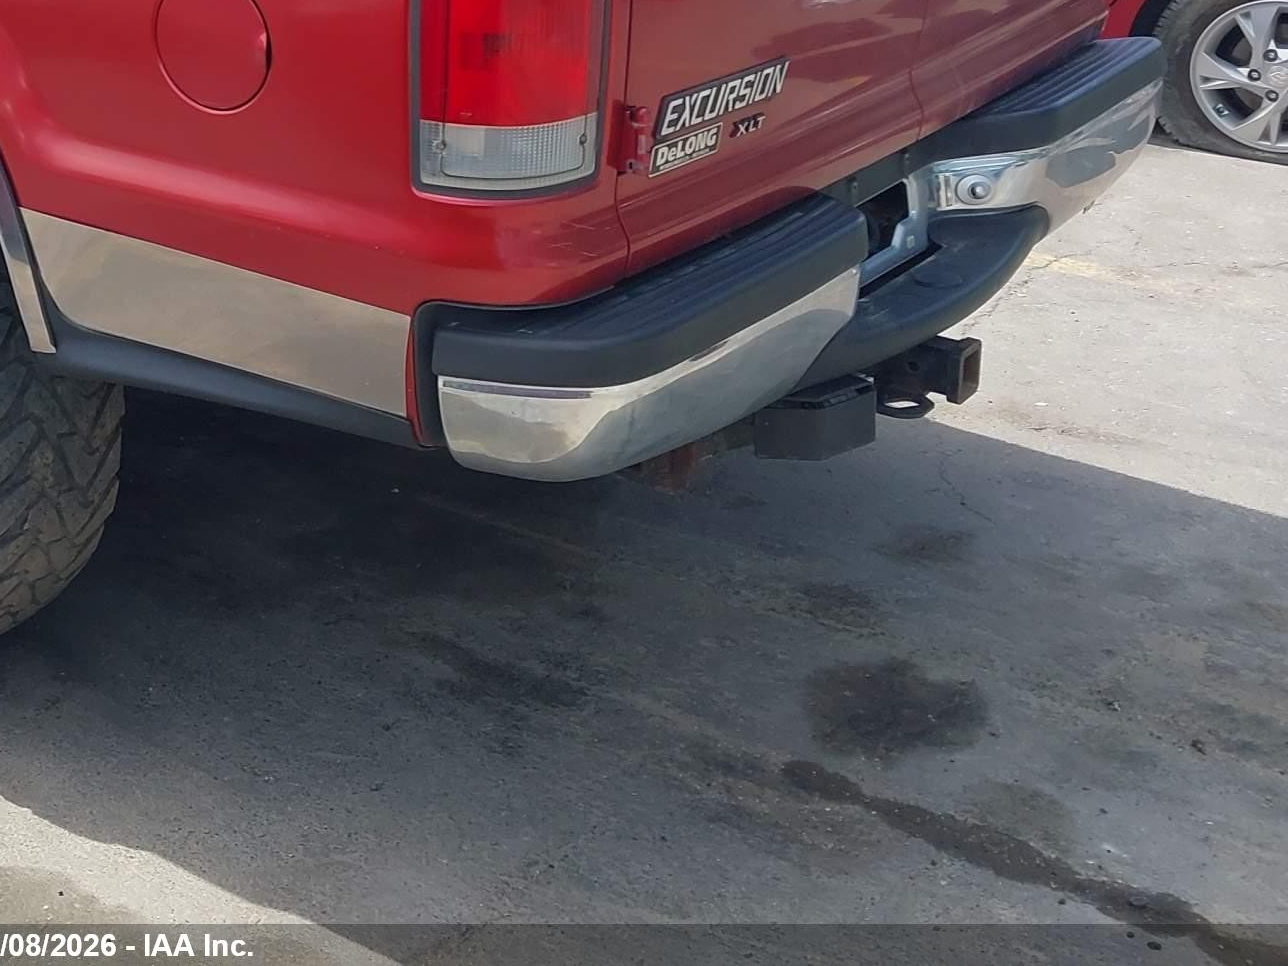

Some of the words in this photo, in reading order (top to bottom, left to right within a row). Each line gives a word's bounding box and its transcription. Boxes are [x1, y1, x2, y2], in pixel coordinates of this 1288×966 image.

[660, 60, 791, 137] EXCURSION
[733, 114, 766, 138] XLT
[655, 127, 718, 167] DeLONG
